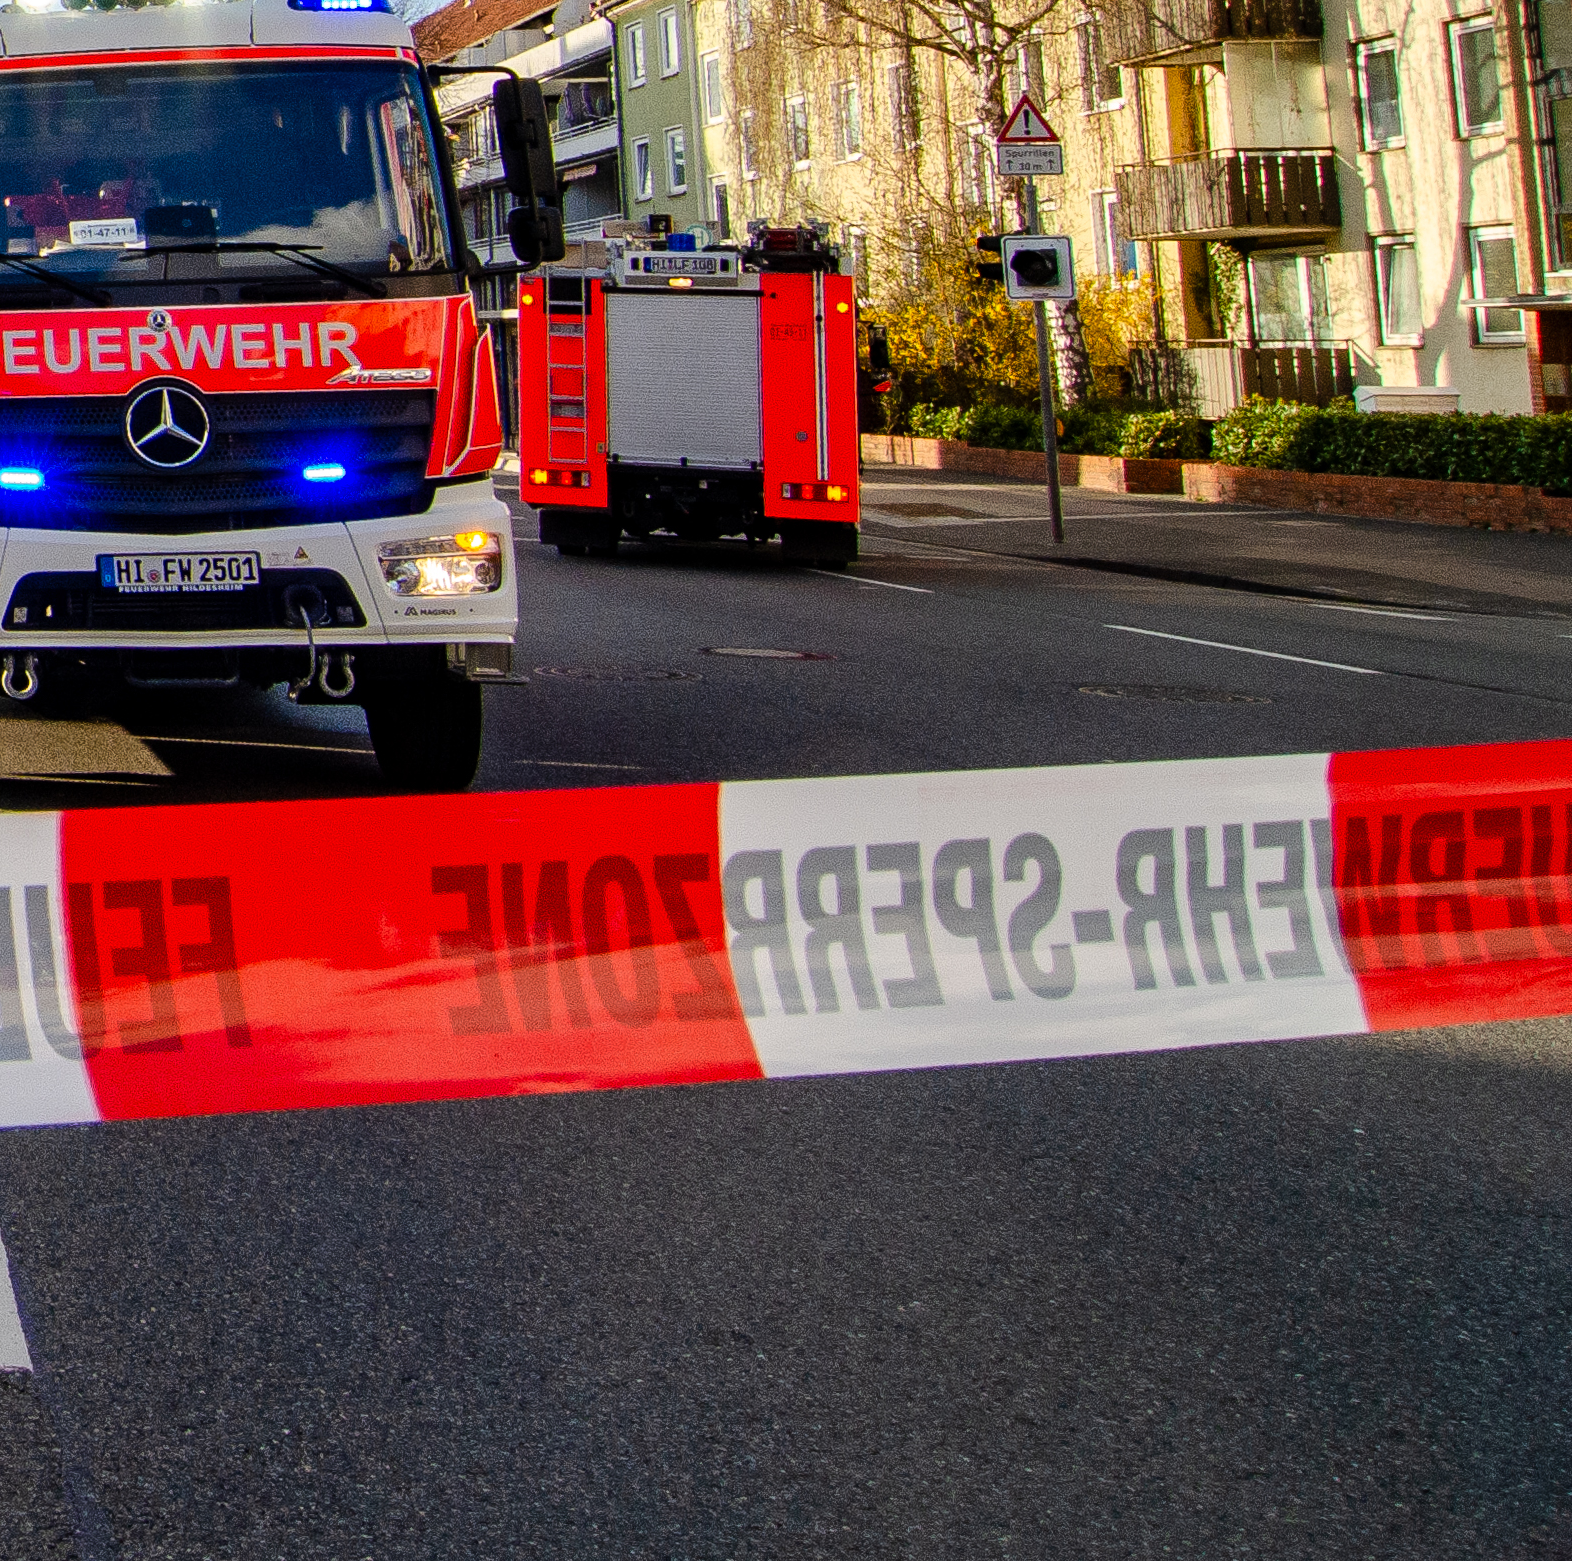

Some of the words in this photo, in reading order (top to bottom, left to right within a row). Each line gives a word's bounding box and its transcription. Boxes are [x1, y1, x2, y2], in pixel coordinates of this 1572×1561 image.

[1005, 149, 1055, 159] Spurrillen
[116, 559, 145, 584] HI
[162, 558, 192, 583] FW
[199, 557, 256, 582] 2501
[118, 585, 179, 593] FEUERWEHR
[182, 584, 244, 592] HILDESHEIM
